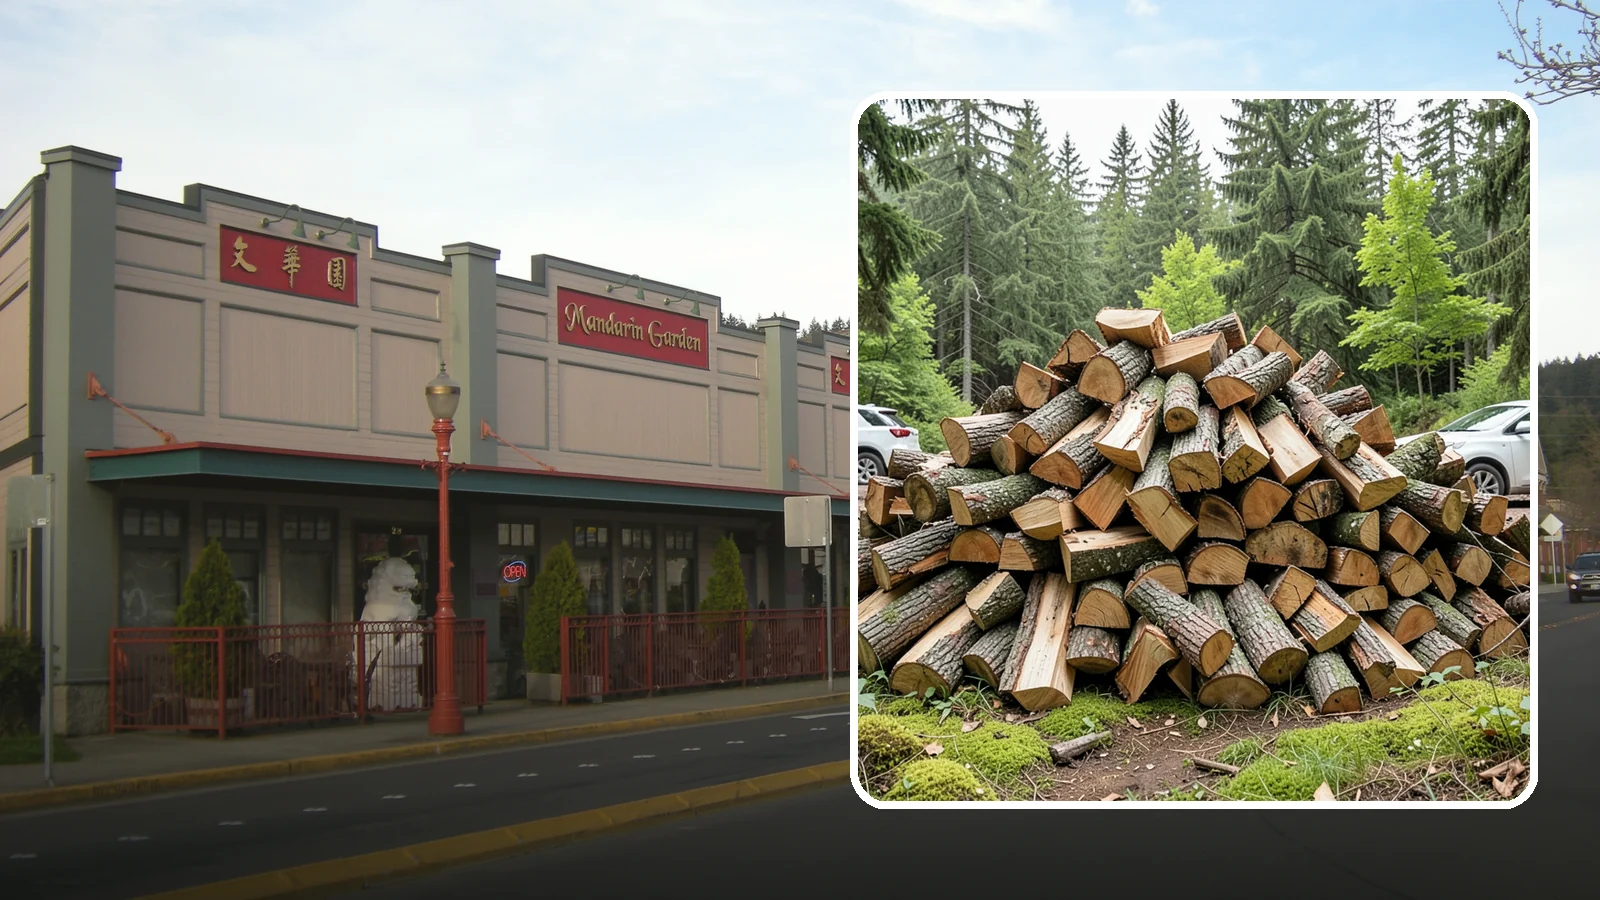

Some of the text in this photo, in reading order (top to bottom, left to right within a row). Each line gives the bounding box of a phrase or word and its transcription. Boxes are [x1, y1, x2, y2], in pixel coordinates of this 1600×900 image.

[231, 236, 346, 291] 文華園
[564, 302, 701, 352] Mandarin Garden
[503, 565, 527, 578] OPEN
